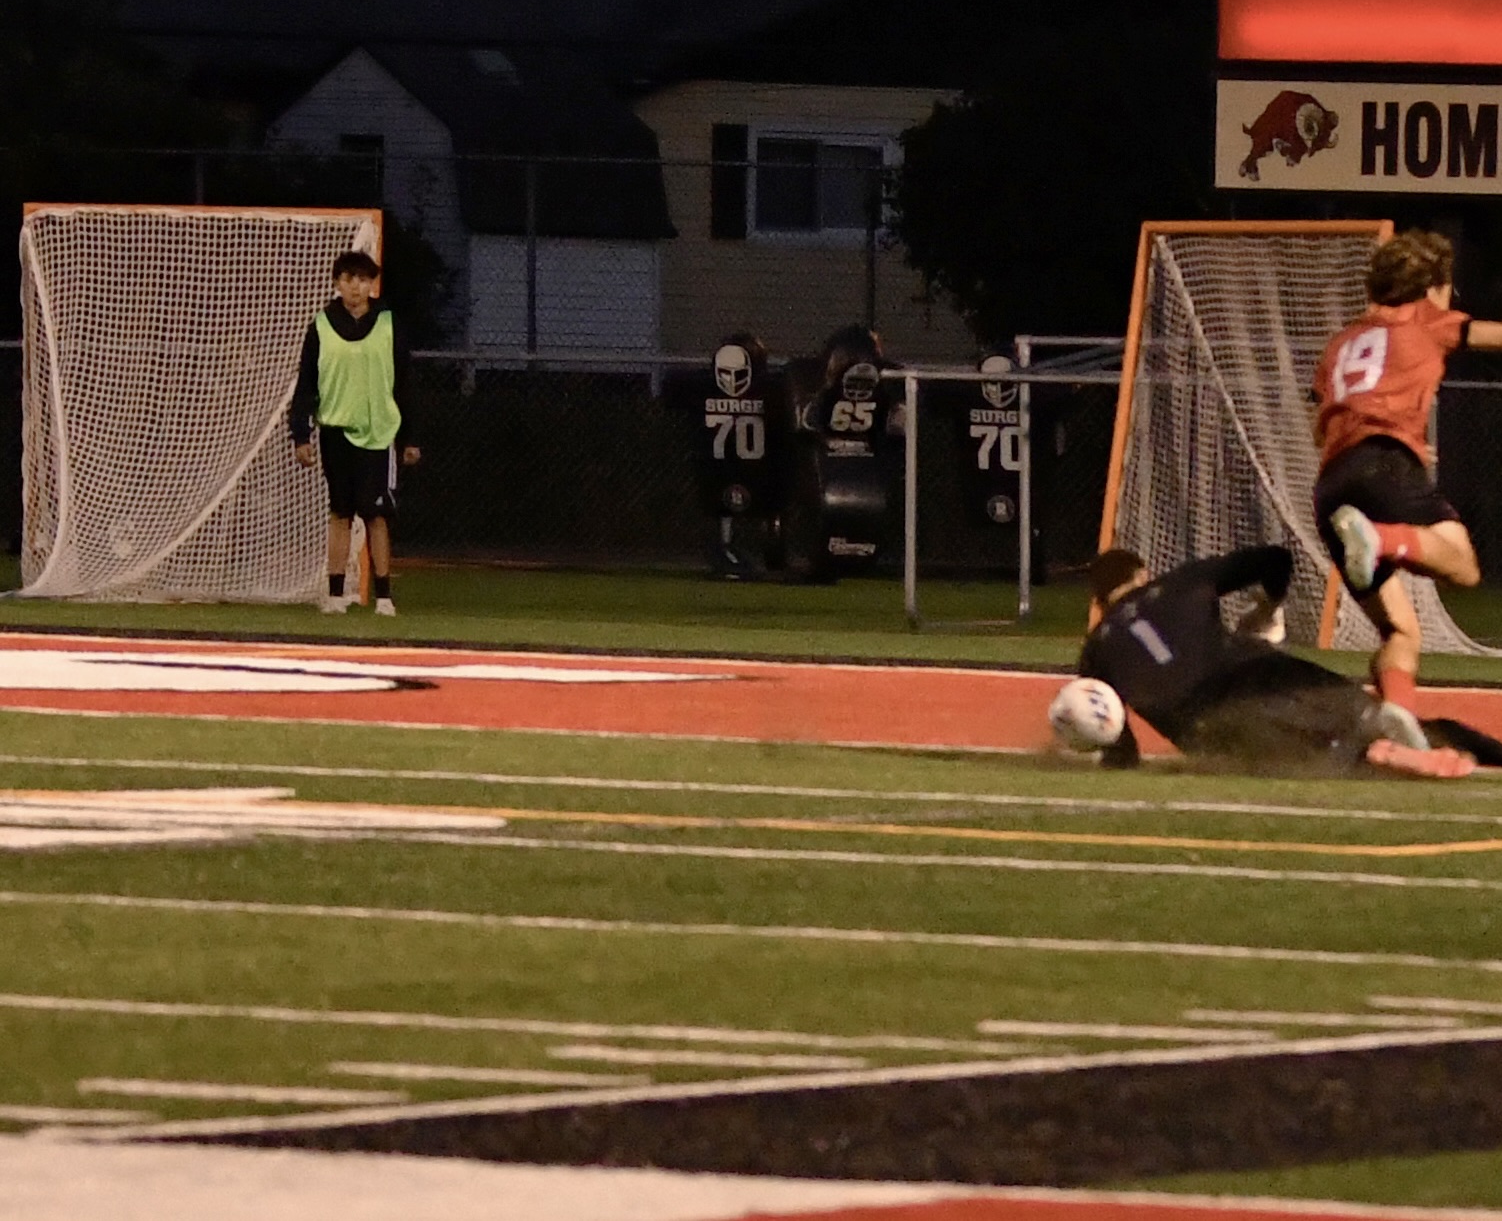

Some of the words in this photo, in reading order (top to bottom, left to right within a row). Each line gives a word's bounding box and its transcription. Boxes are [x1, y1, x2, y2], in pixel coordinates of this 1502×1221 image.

[1332, 326, 1387, 403] 19
[705, 414, 765, 460] 70
[830, 401, 876, 432] 65
[969, 425, 1023, 471] 70
